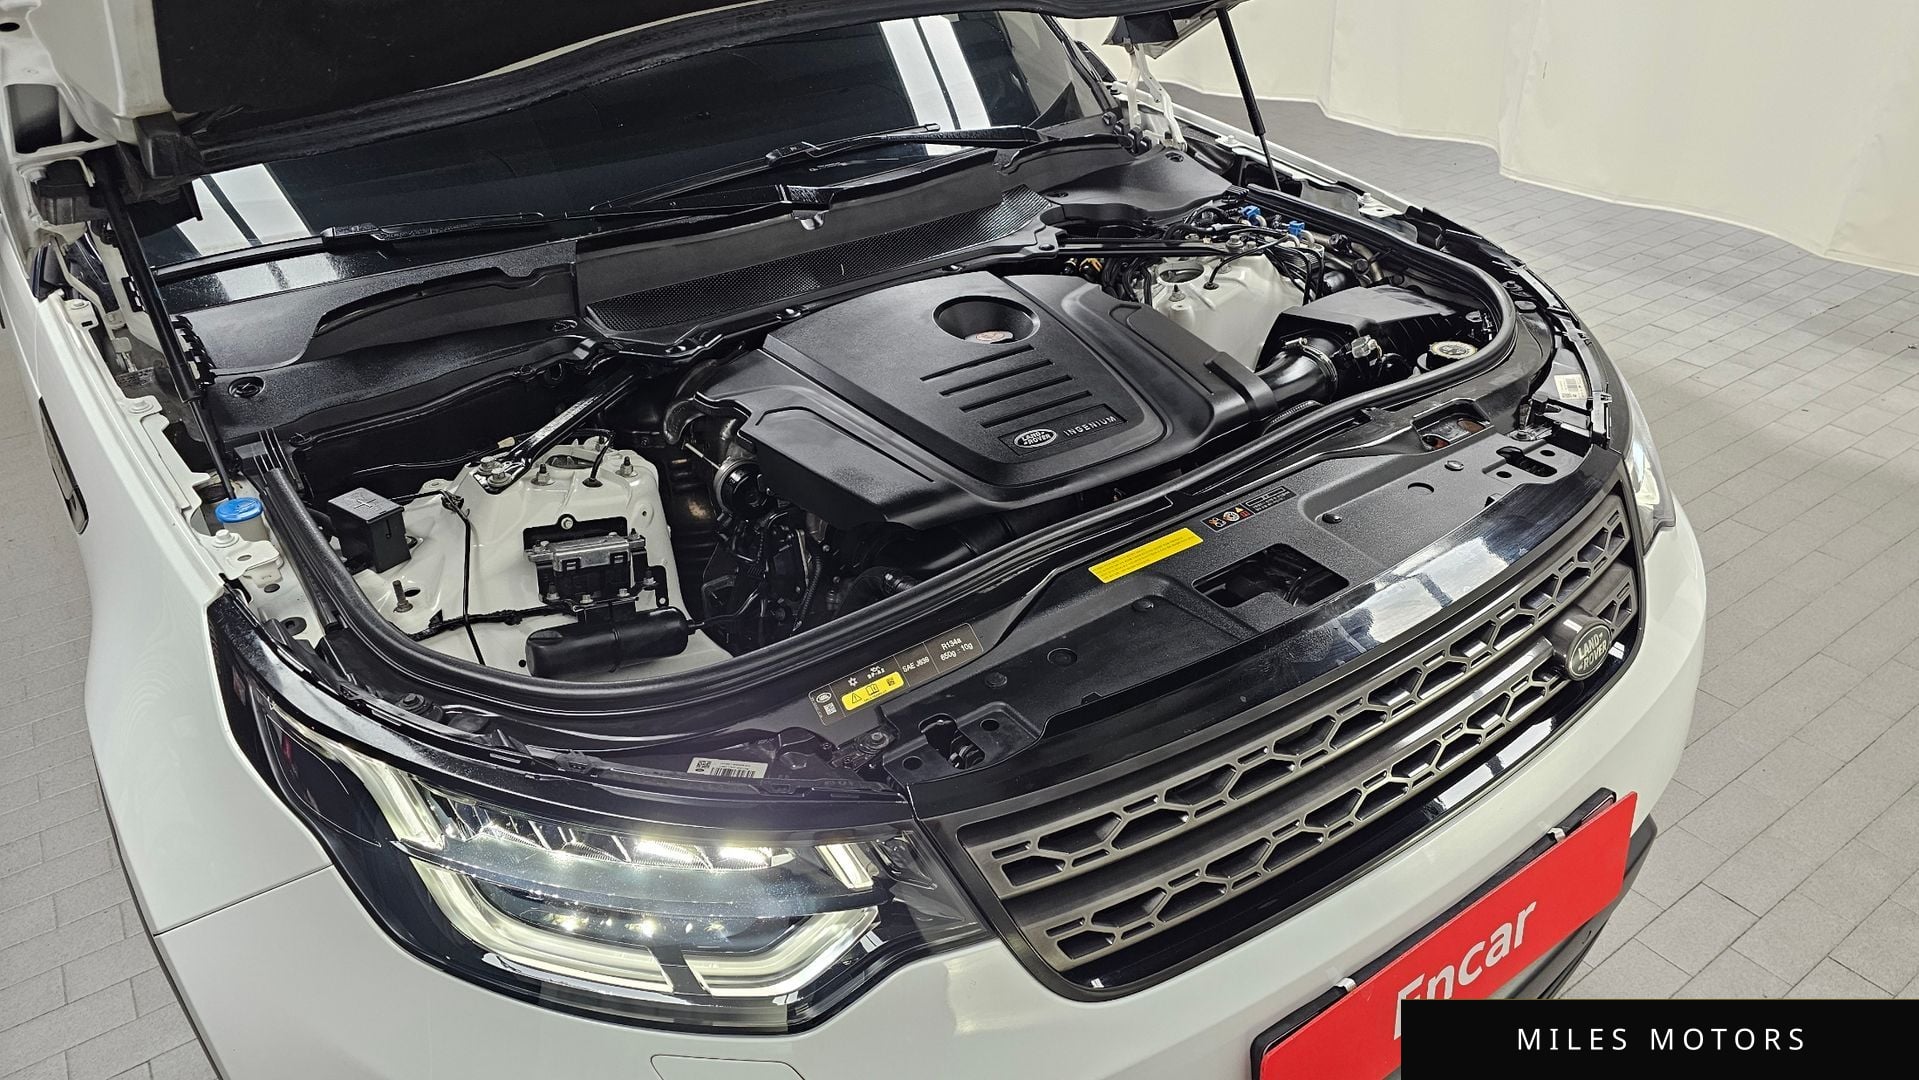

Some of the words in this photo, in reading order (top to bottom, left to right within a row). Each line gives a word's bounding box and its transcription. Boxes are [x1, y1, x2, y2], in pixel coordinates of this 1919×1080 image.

[1063, 415, 1117, 436] INGENIUM
[1021, 431, 1041, 441] LAND
[1028, 433, 1051, 444] ROVER
[941, 638, 962, 650] R134a
[961, 642, 973, 652] 10g
[1578, 633, 1600, 660] LAND
[1583, 640, 1607, 670] ROVER
[902, 662, 916, 673] SAE
